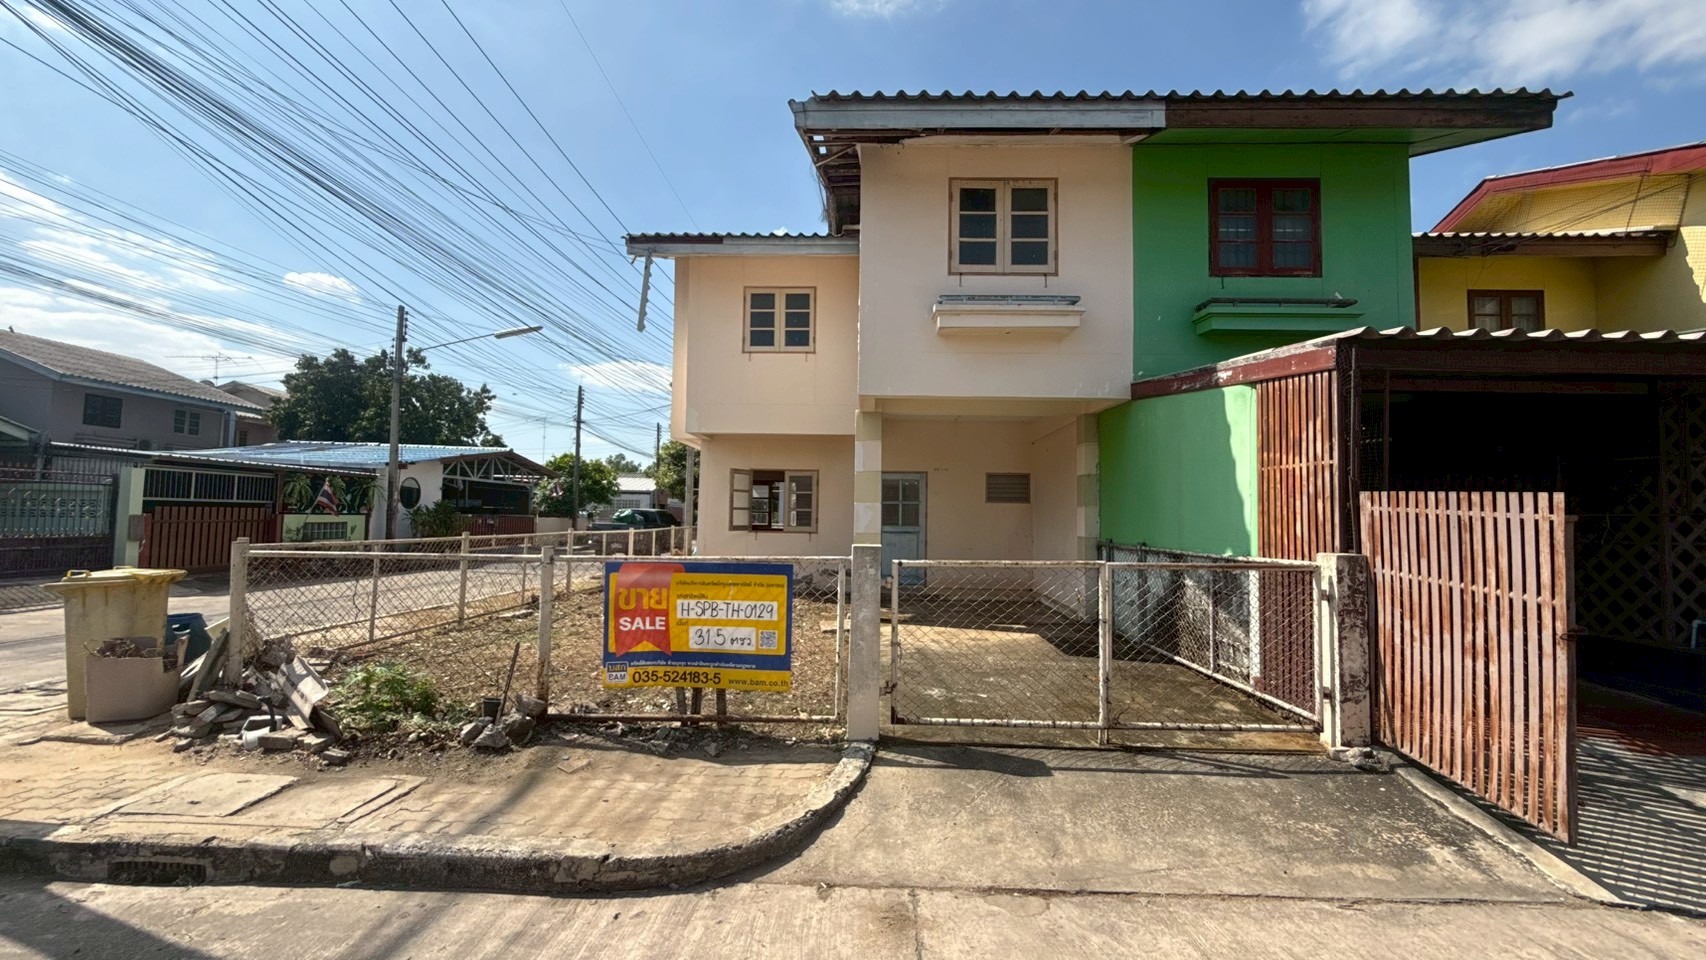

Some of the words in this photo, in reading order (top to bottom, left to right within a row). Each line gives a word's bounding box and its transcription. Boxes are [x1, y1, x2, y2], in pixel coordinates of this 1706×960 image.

[619, 587, 668, 611] ขาย
[681, 601, 775, 619] H-SPB-TH-0129
[618, 616, 666, 632] SALE
[608, 673, 626, 681] BAM
[632, 670, 721, 685] 035-524183-5
[728, 679, 789, 687] www.bam.co.th
